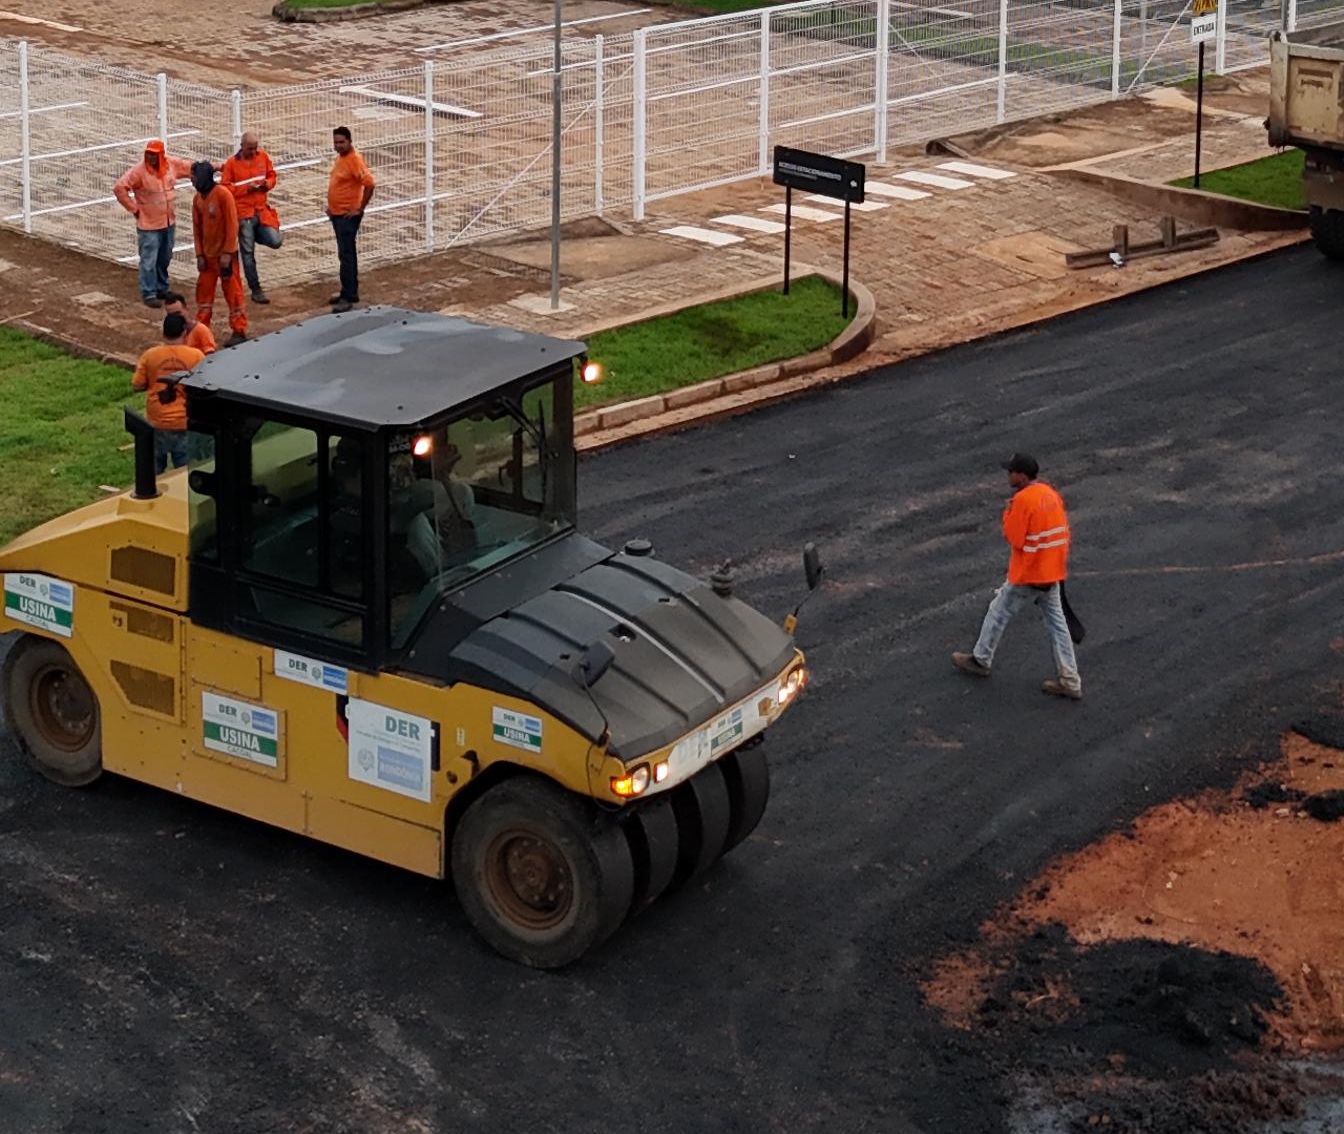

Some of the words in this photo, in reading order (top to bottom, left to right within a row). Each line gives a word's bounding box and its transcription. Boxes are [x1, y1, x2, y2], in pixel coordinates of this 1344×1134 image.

[1193, 22, 1215, 36] ENTRADA
[19, 596, 57, 622] USINA
[287, 658, 308, 673] DER
[218, 704, 237, 717] DER
[385, 715, 420, 740] DER
[219, 726, 261, 752] USINA
